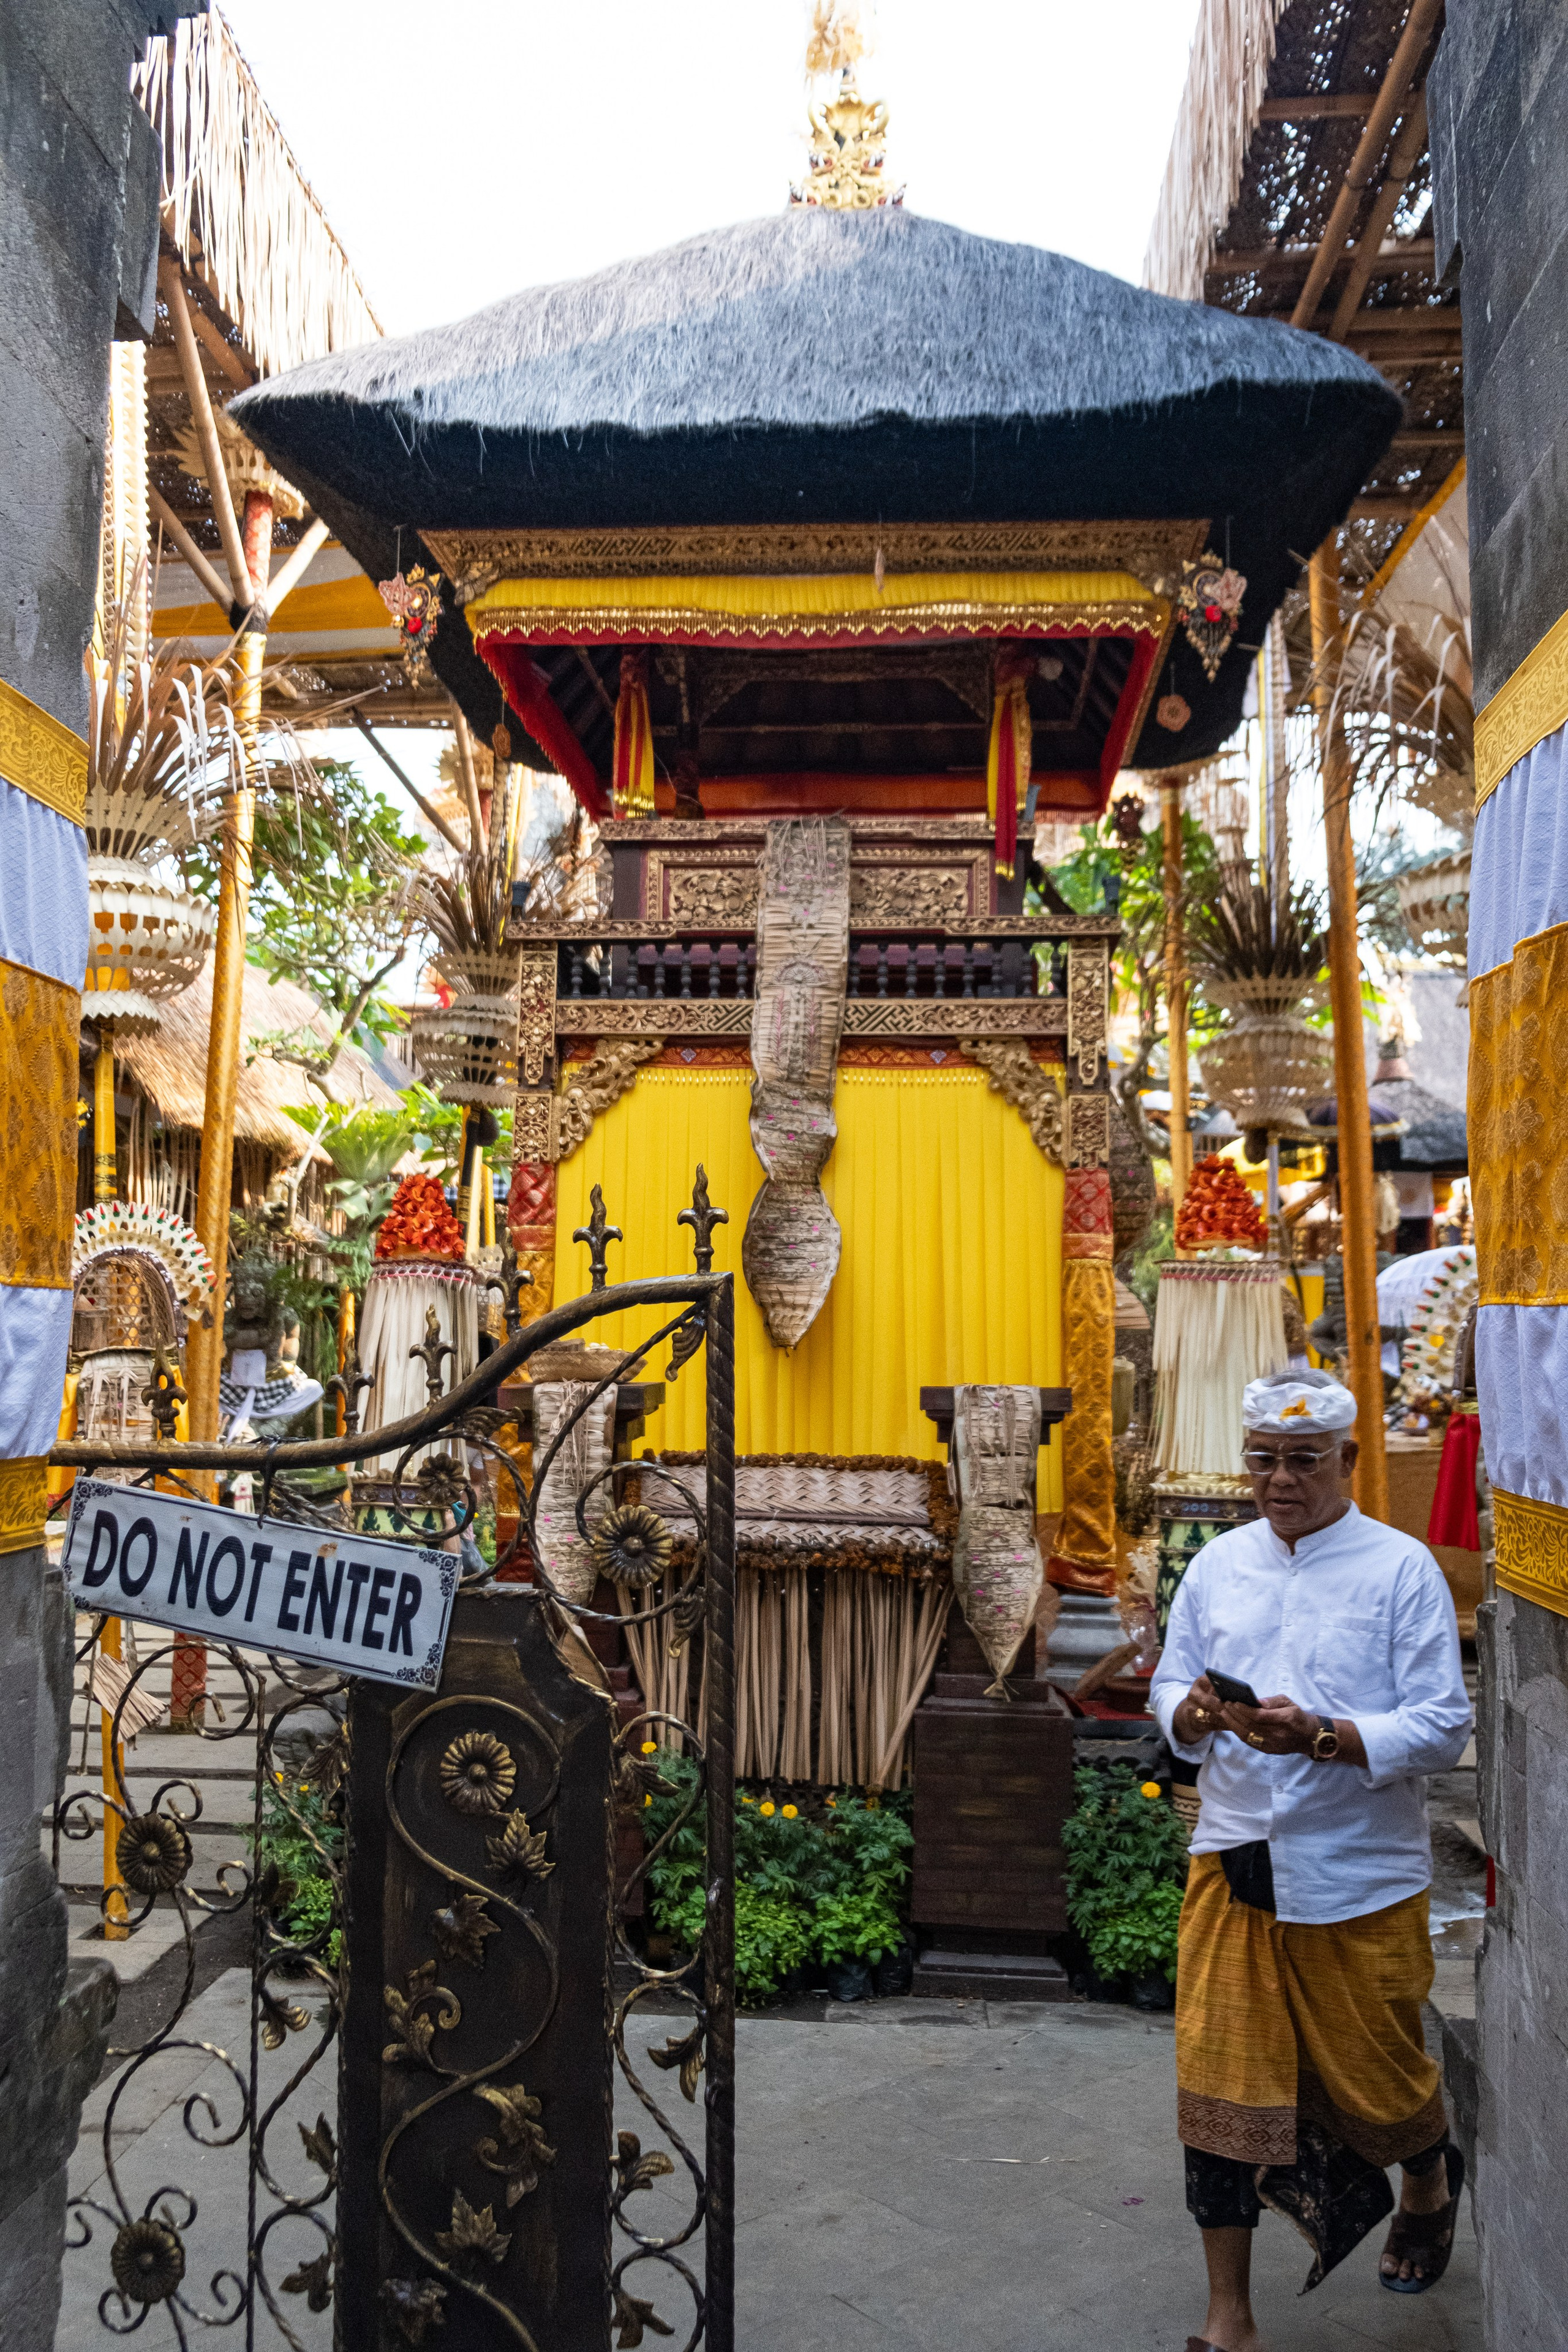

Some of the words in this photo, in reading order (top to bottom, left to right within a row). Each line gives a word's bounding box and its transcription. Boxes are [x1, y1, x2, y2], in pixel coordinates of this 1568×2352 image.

[82, 1510, 158, 1597] DO
[168, 1526, 273, 1622] NOT
[277, 1550, 422, 1656] ENTER
